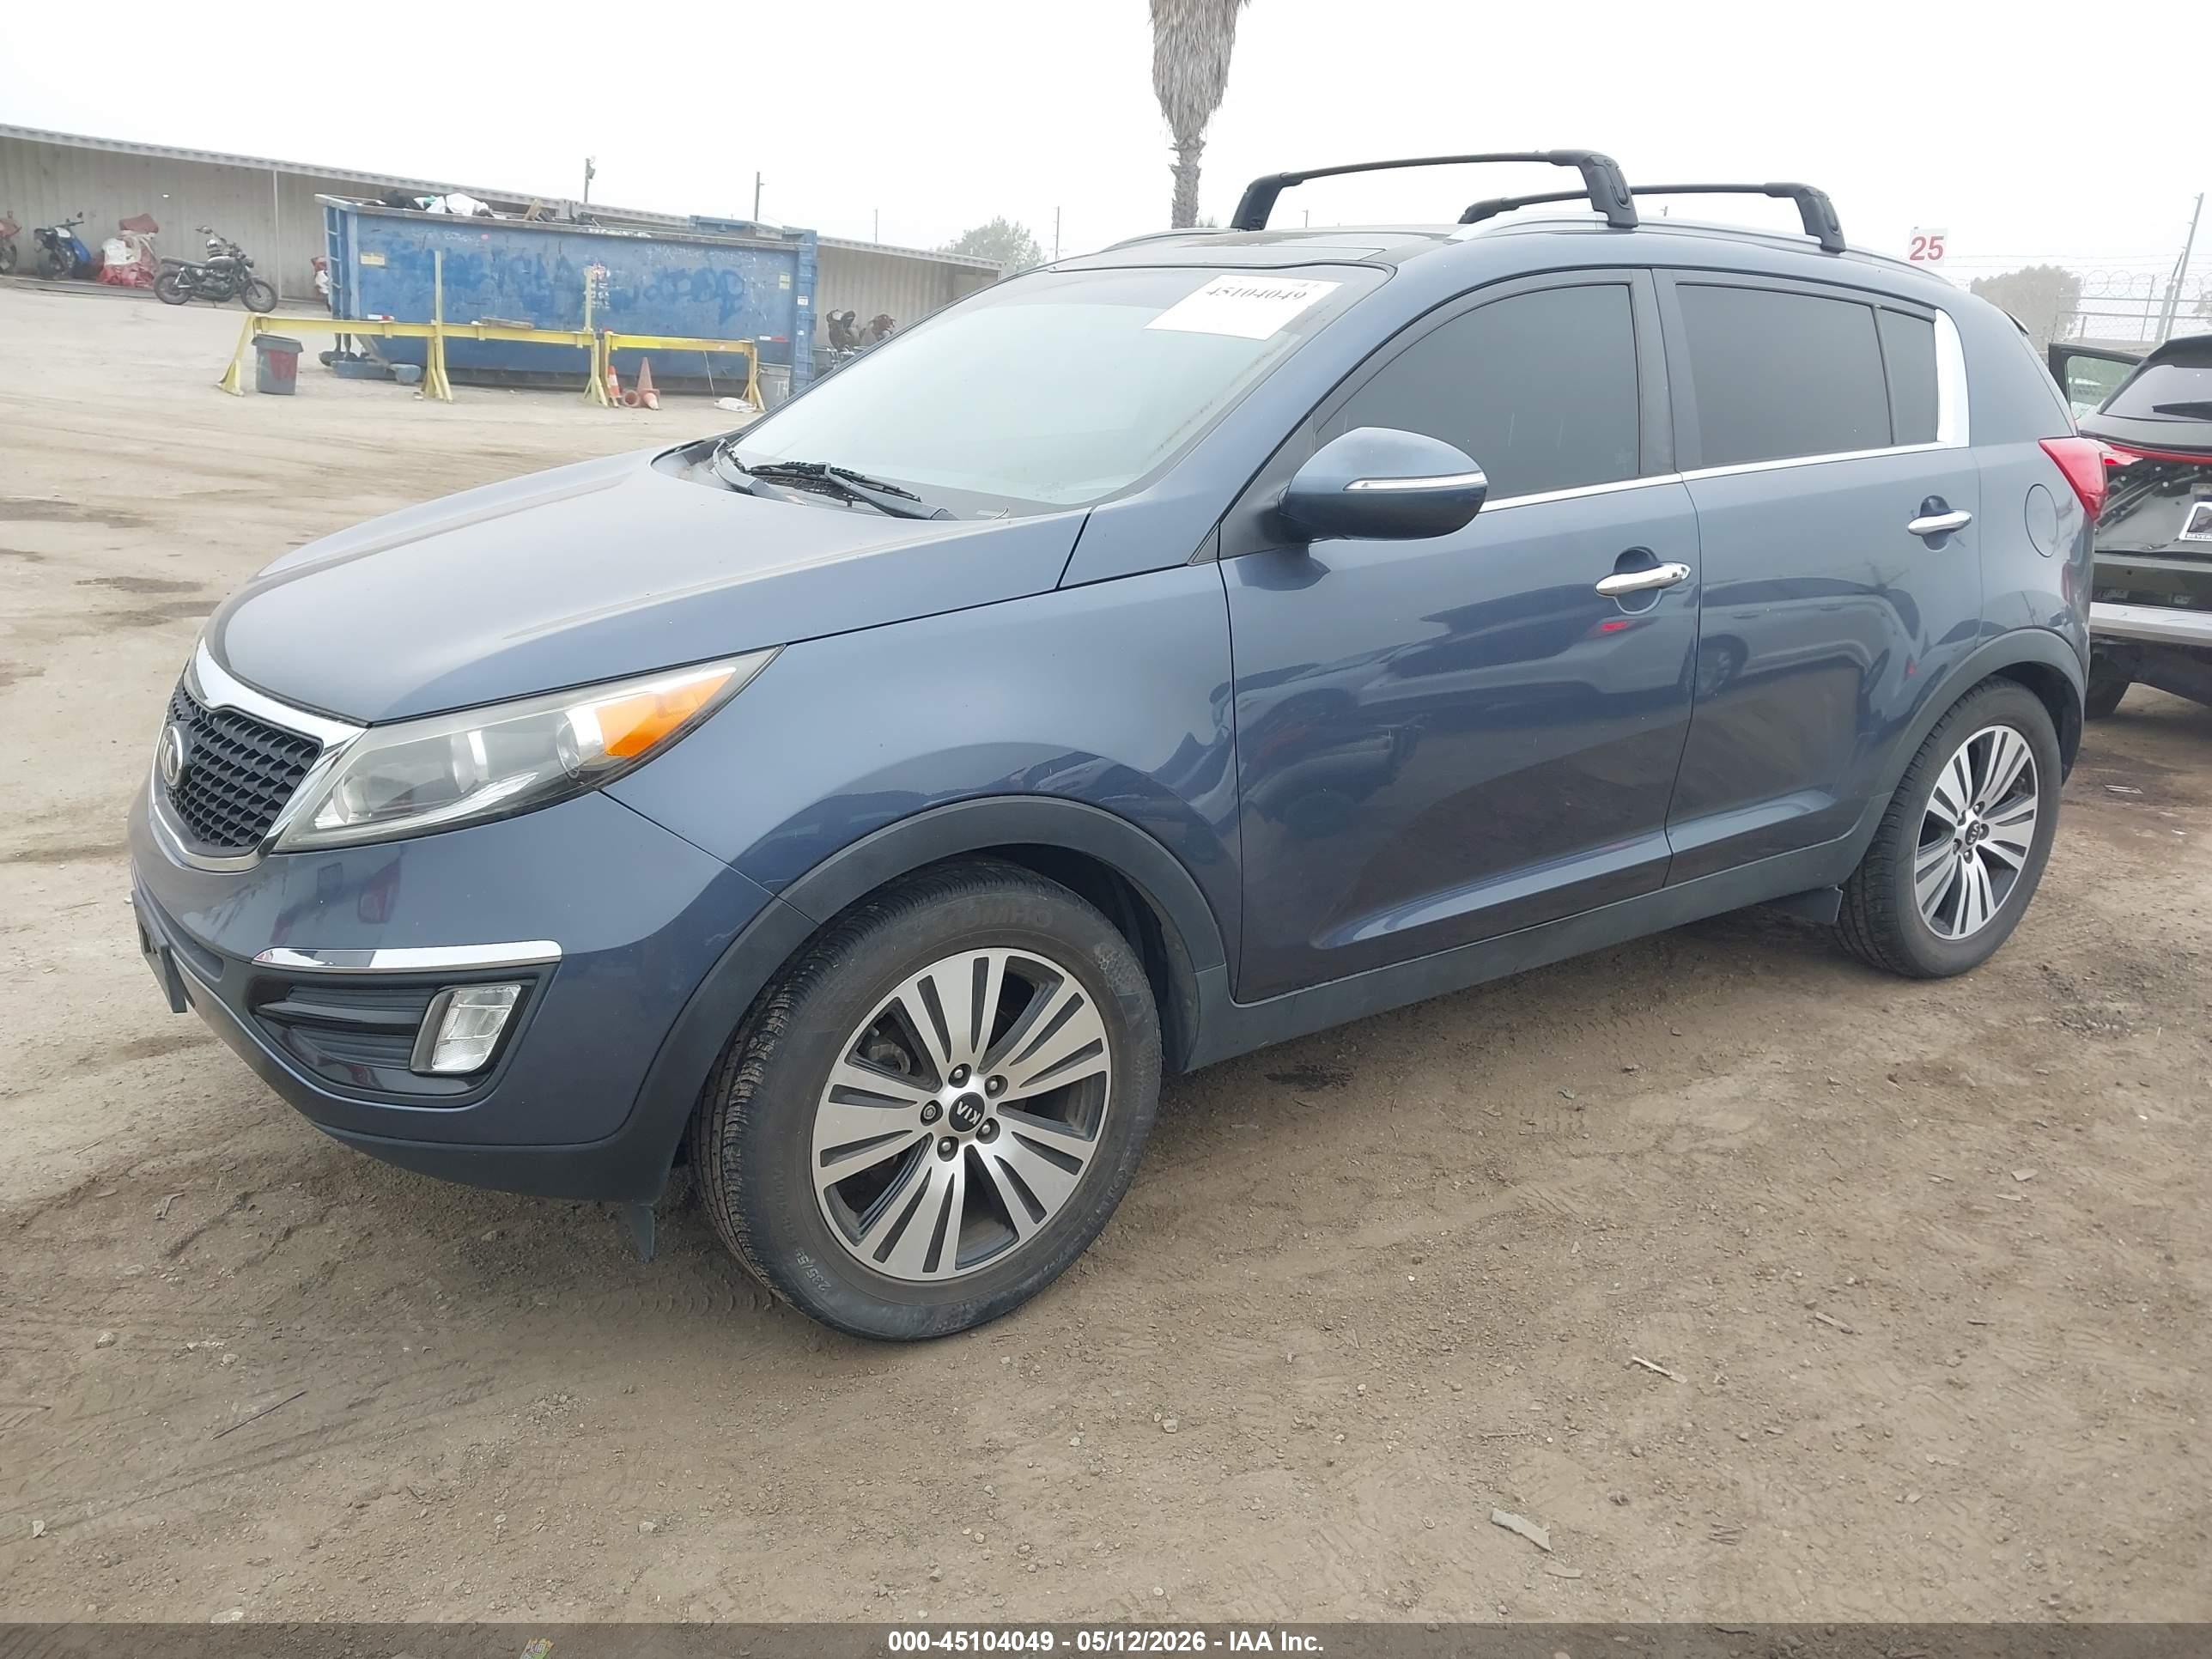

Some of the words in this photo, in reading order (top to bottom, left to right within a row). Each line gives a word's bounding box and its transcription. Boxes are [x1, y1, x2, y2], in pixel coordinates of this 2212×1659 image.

[1909, 235, 1944, 260] 25
[1206, 287, 1307, 300] 45104049
[1968, 823, 1978, 842] KIA
[957, 1101, 981, 1125] KIA
